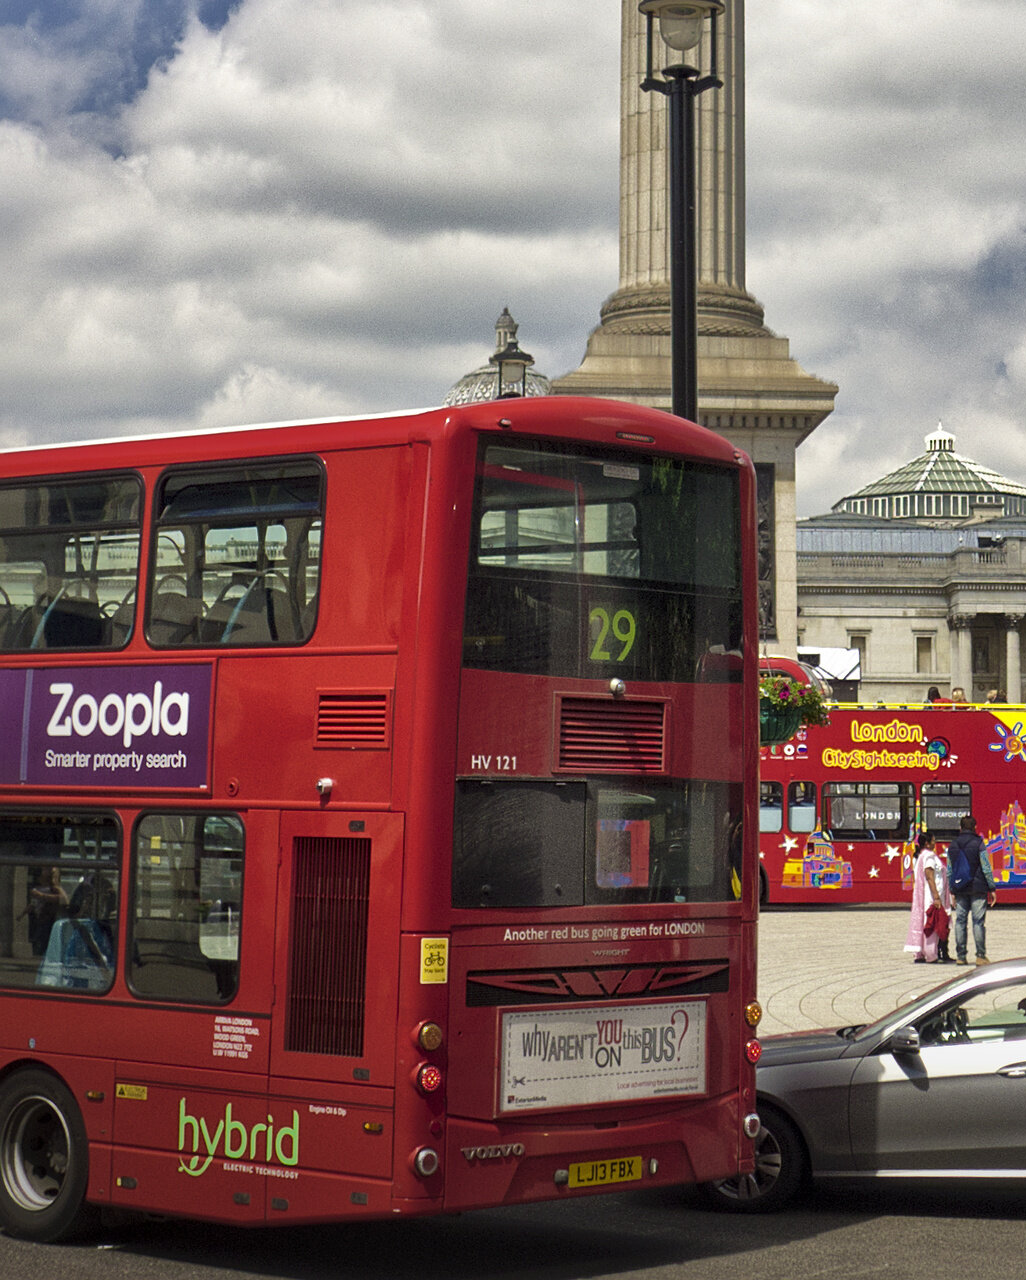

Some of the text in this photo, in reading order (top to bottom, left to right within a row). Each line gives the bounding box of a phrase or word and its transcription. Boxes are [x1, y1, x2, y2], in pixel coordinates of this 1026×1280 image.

[588, 607, 636, 662] 29
[47, 680, 190, 748] Zoopla
[851, 719, 923, 742] London
[45, 749, 187, 771] Smarter property search
[471, 754, 517, 770] HV 121
[822, 748, 940, 771] CitySightseeing
[855, 812, 901, 820] LONDON
[503, 922, 705, 941] Another red bus going green for LONDON
[592, 948, 630, 956] WRIGHT
[596, 1019, 623, 1045] YOU
[548, 1033, 597, 1062] AREN'T
[623, 1029, 641, 1050] this
[595, 1046, 622, 1068] ON
[178, 1097, 299, 1177] hybrid
[461, 1143, 525, 1160] VOLVO
[223, 1162, 299, 1180] ELECTRIC TECHNOLOGY
[577, 1160, 634, 1183] LJ13 FBX
